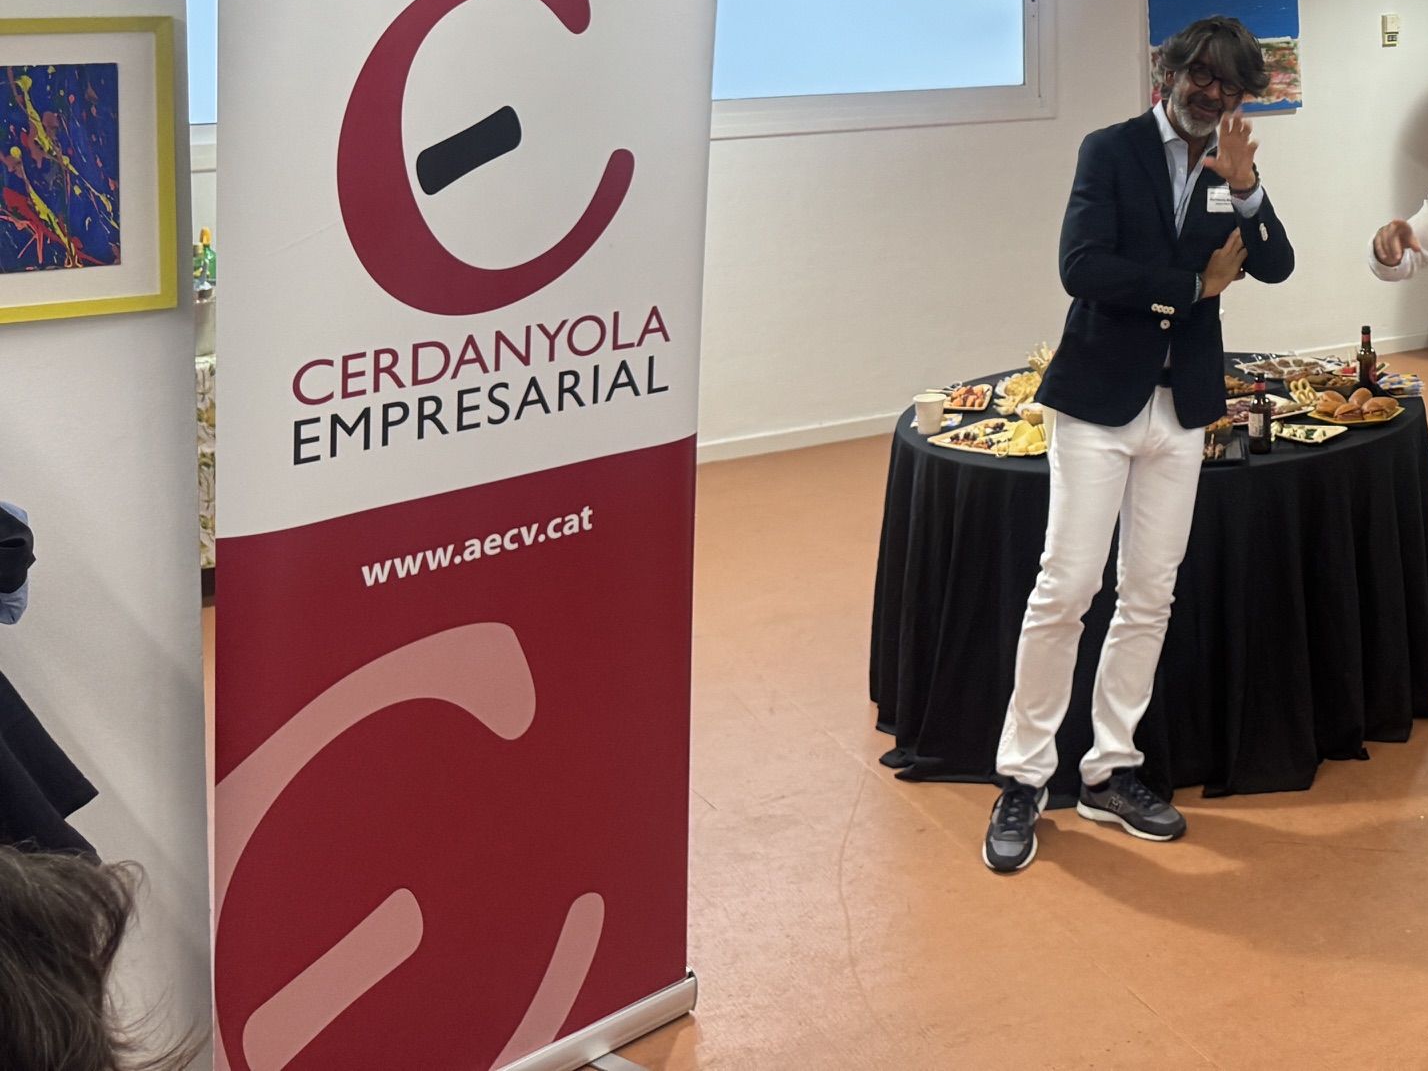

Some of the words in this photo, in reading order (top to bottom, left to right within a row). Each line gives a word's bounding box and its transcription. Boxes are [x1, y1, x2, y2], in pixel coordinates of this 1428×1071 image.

[292, 305, 671, 406] CERDANYOLA
[293, 355, 670, 466] EMPRESARIAL
[361, 505, 594, 588] www.aecv.cat
